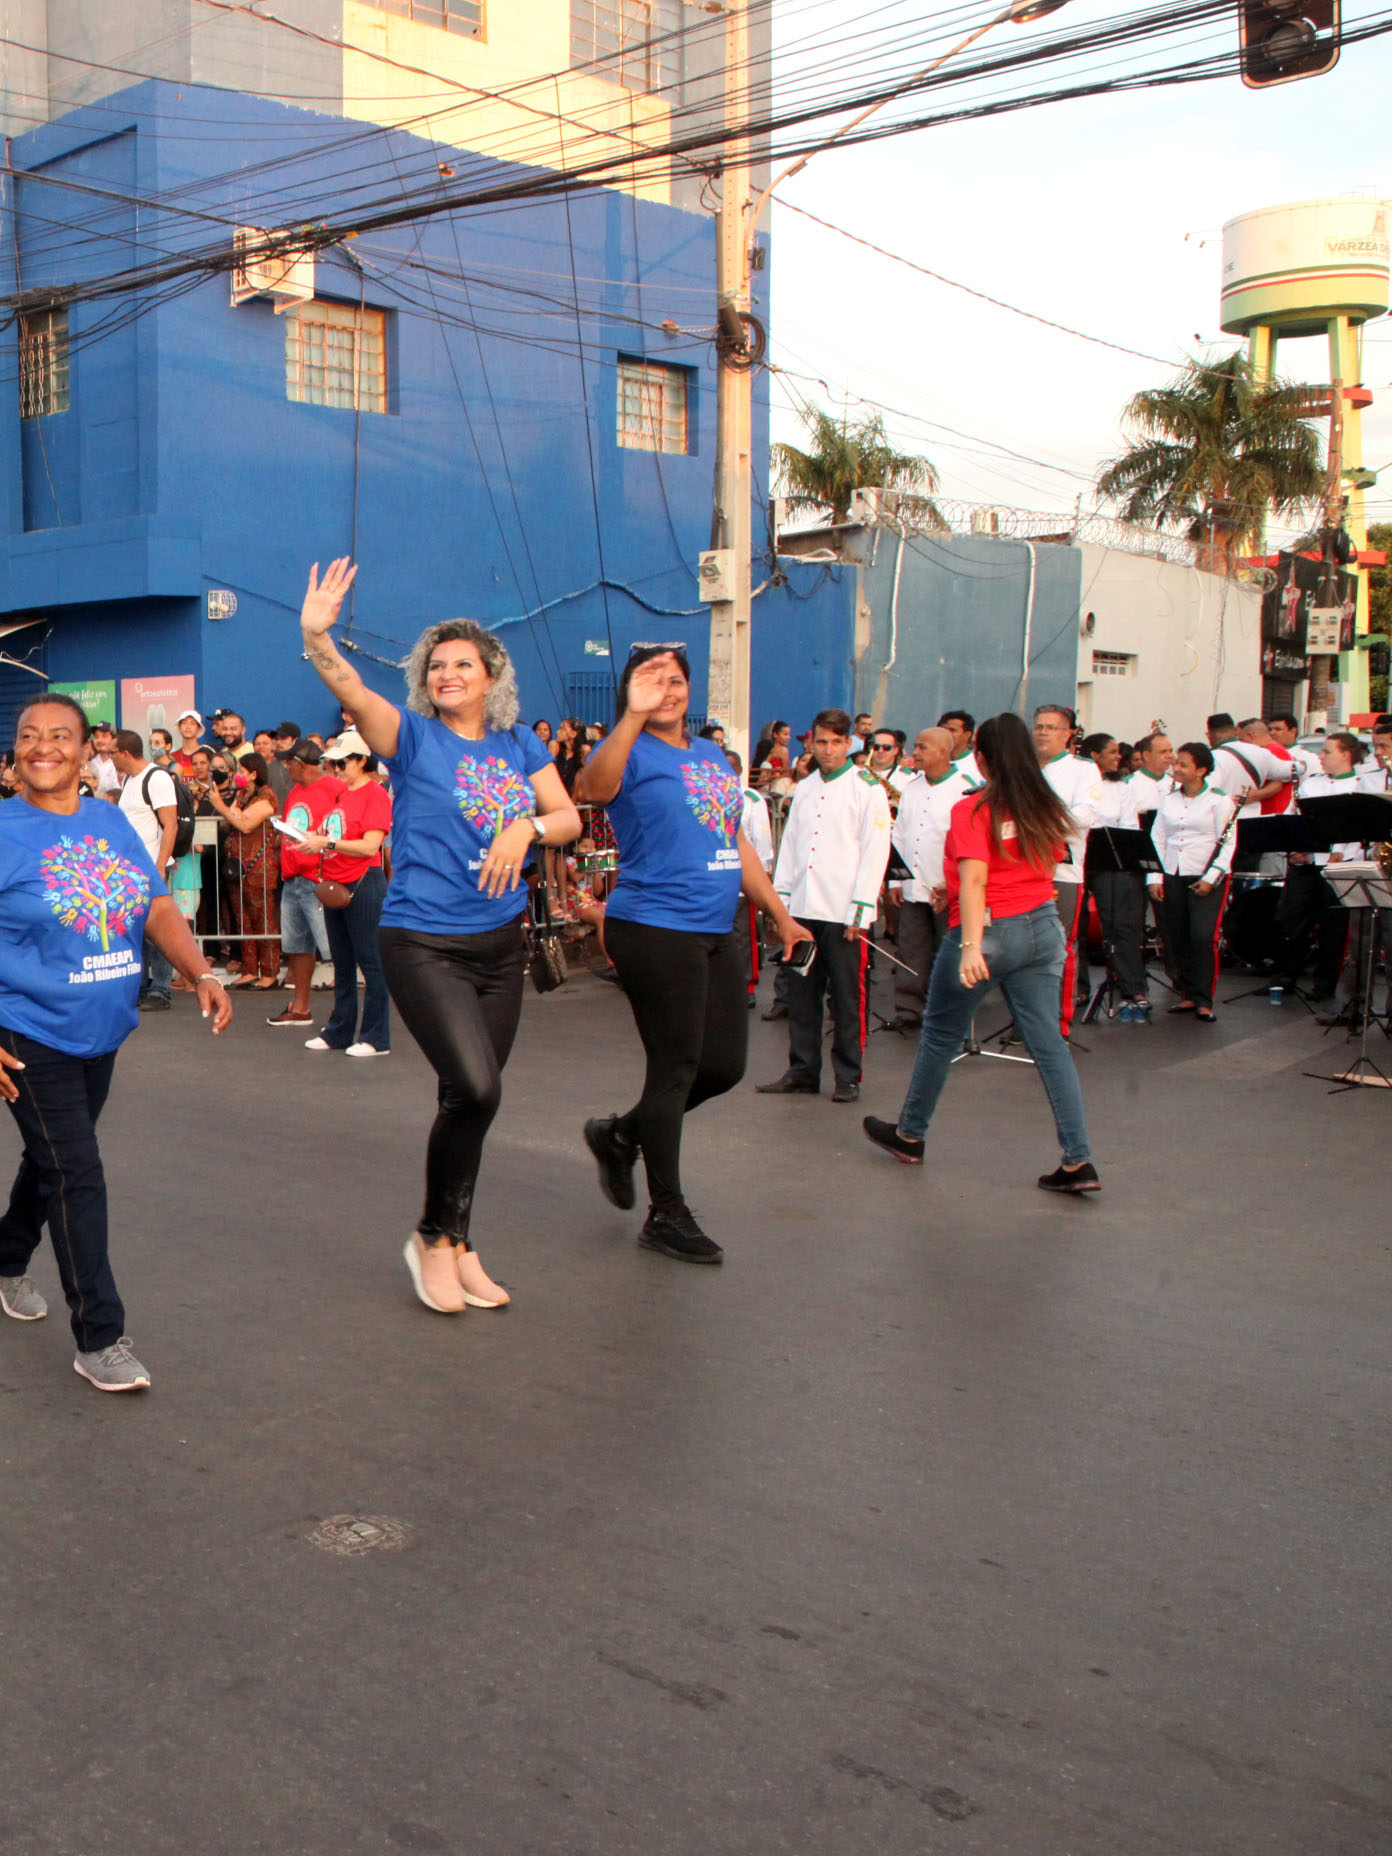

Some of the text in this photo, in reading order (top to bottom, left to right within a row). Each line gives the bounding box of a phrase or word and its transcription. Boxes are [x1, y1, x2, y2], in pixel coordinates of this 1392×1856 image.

[82, 949, 134, 970] CMAEAPI
[68, 971, 94, 984] João
[94, 967, 127, 982] Ribeiro
